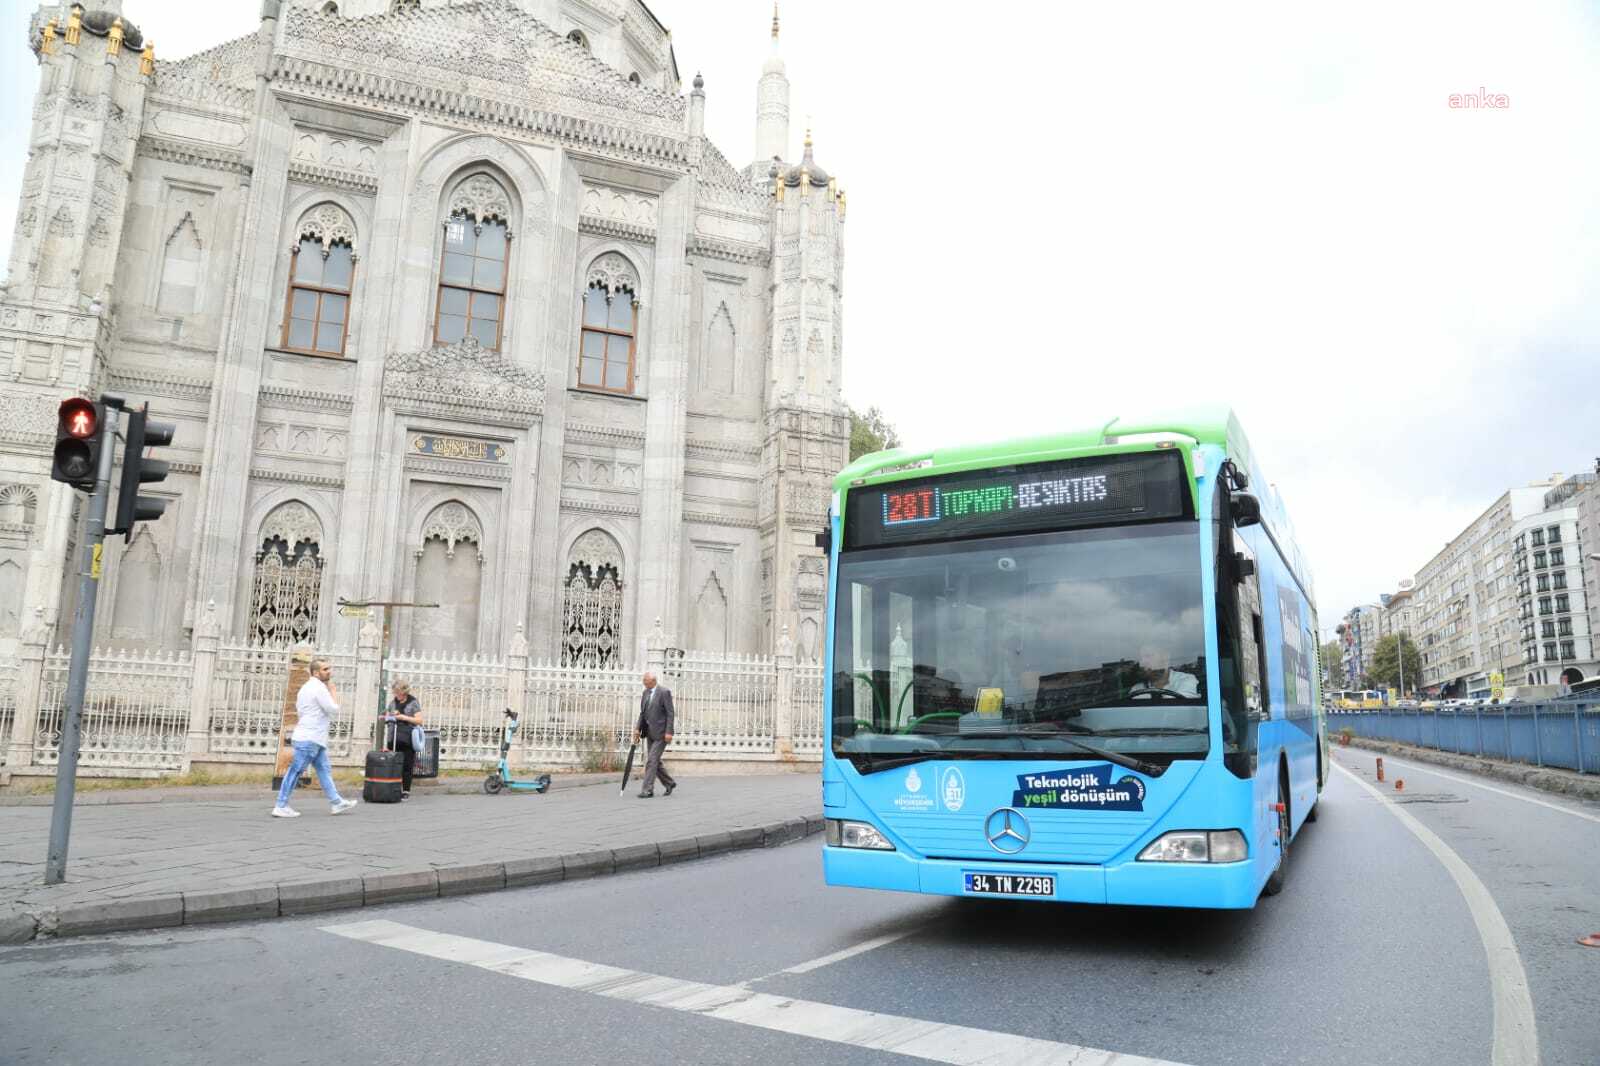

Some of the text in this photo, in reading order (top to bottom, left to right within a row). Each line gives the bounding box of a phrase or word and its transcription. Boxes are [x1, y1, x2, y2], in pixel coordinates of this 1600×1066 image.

[888, 490, 934, 521] 28T
[1025, 774, 1100, 790] Teknolojik
[1024, 789, 1130, 807] yeşil dönüşüm
[973, 875, 1051, 894] 34 TN 2298
